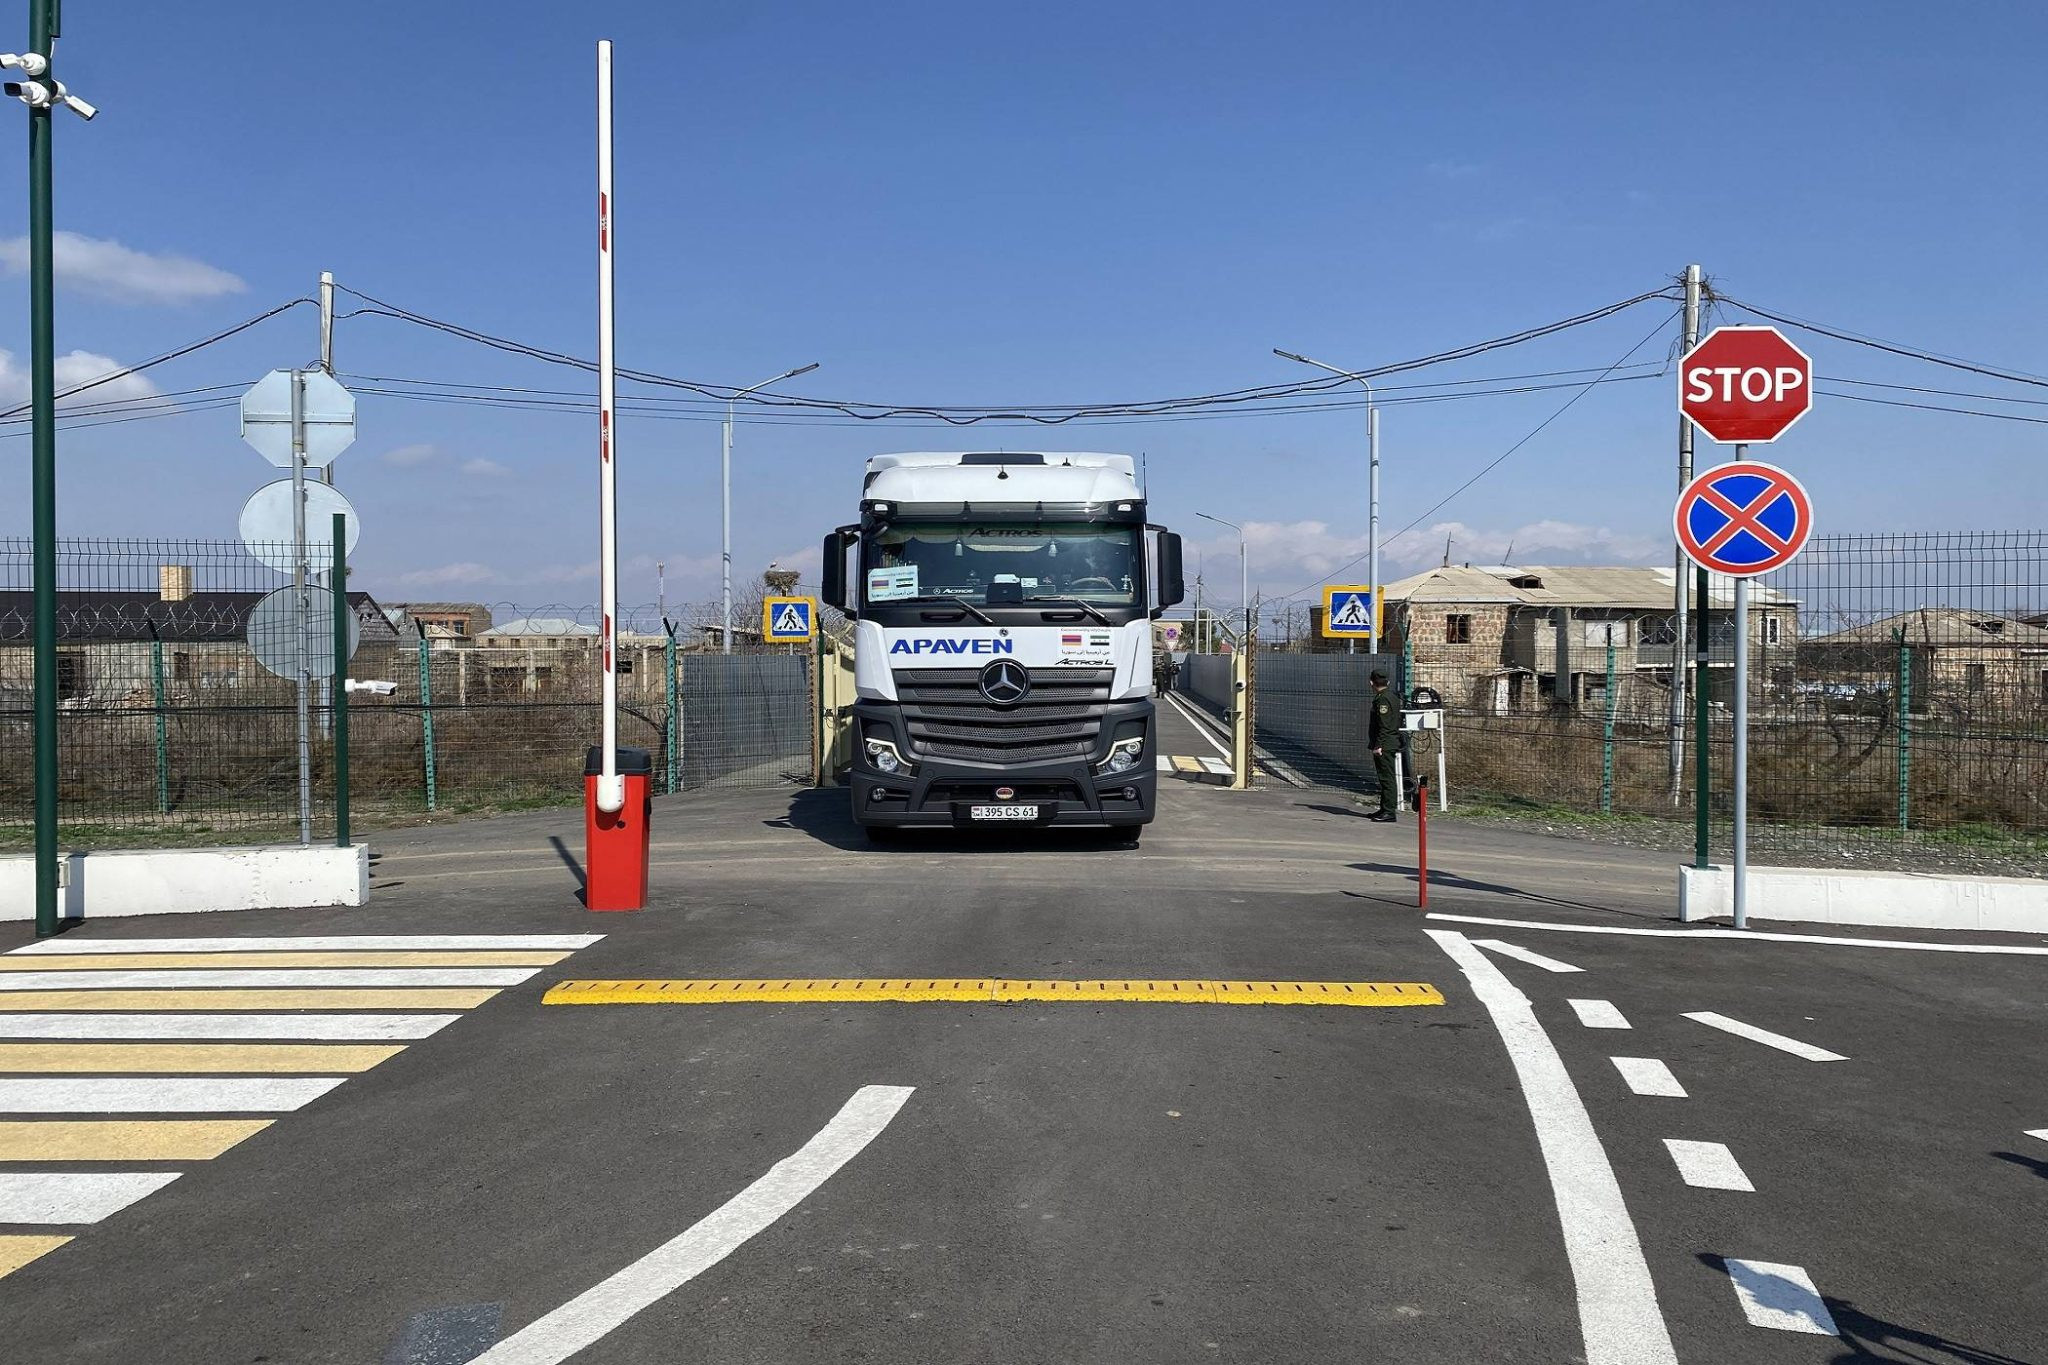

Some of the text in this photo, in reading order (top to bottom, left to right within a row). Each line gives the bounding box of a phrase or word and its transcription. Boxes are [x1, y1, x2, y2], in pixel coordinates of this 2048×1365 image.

[1686, 367, 1803, 403] STOP
[889, 639, 1013, 654] APAVEN
[984, 807, 1035, 817] 395 CS 61
